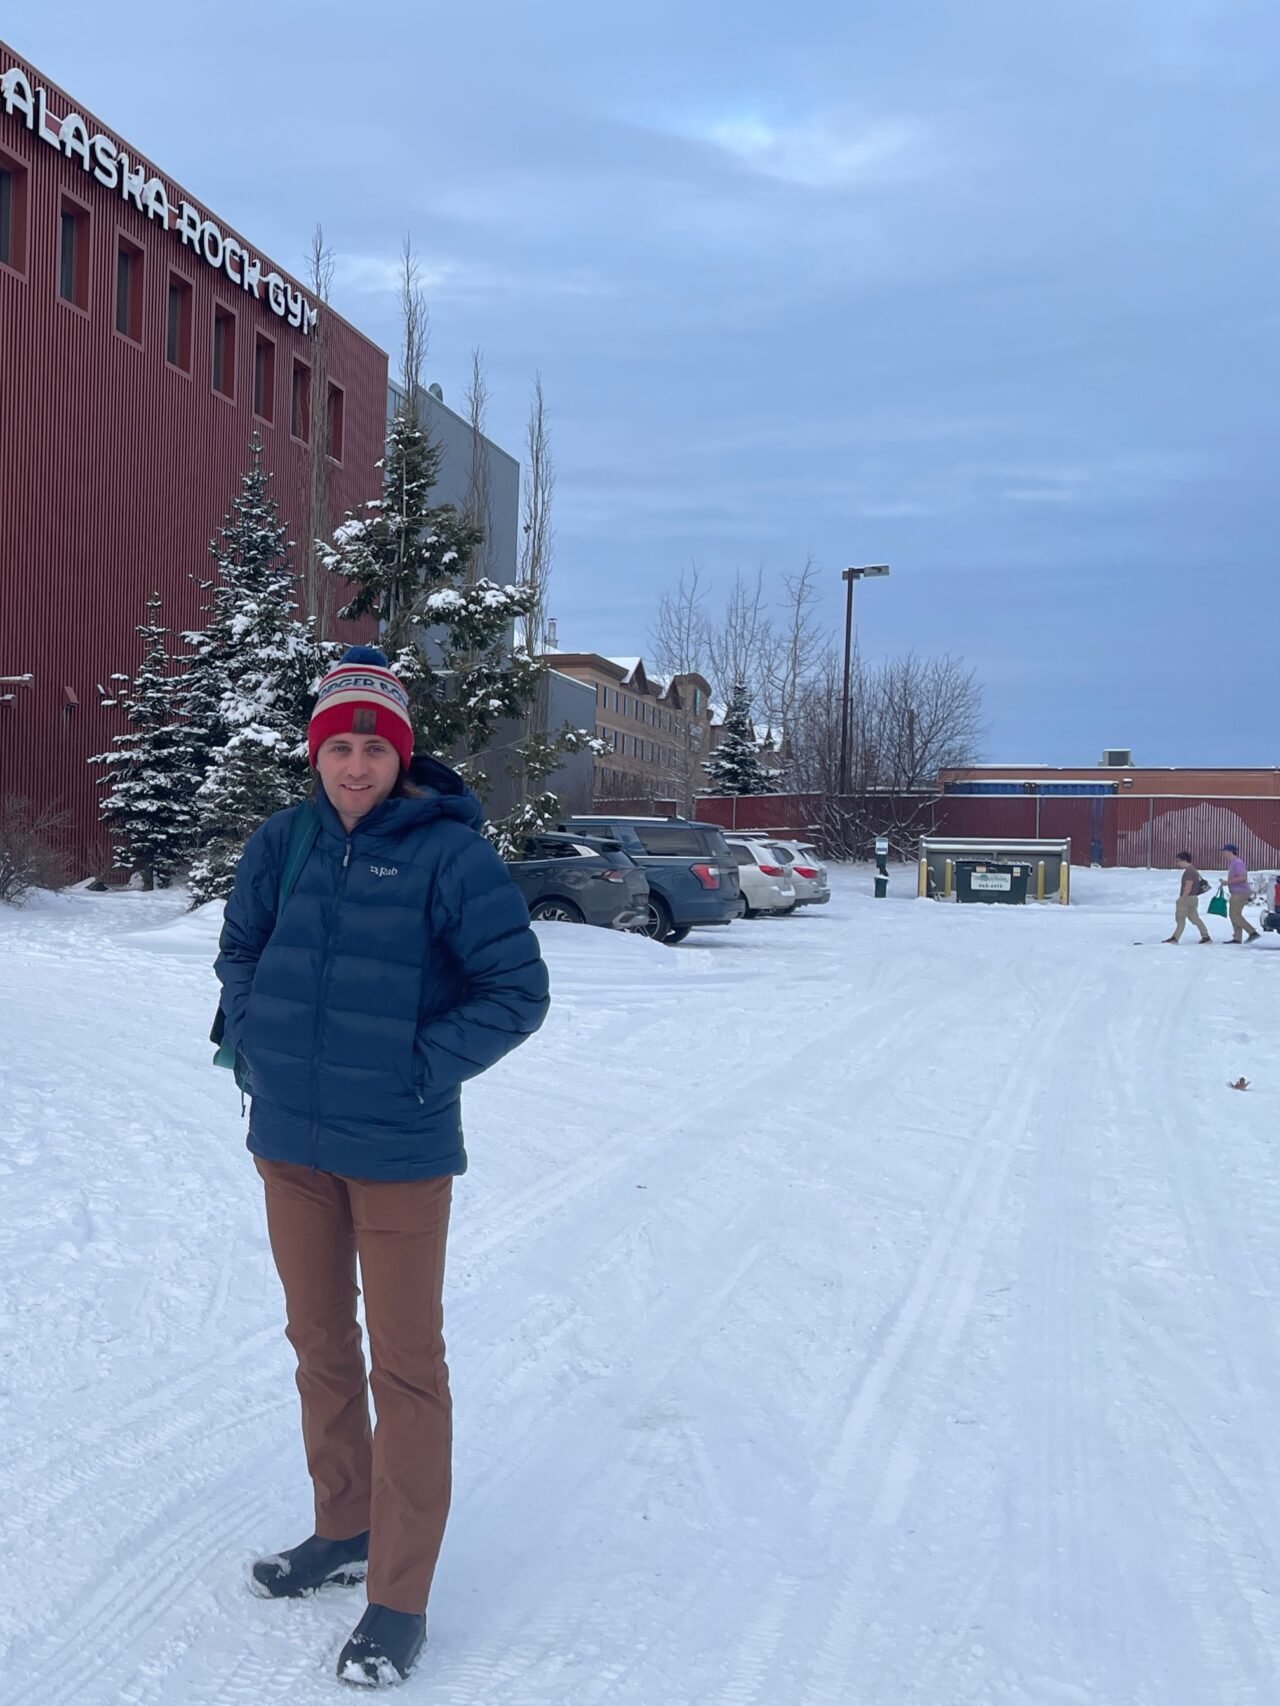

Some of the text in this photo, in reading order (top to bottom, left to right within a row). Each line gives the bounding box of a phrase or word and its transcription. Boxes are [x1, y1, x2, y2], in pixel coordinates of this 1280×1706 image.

[175, 200, 261, 300] ROCK
[265, 272, 318, 338] GYM
[378, 866, 399, 877] Rab
